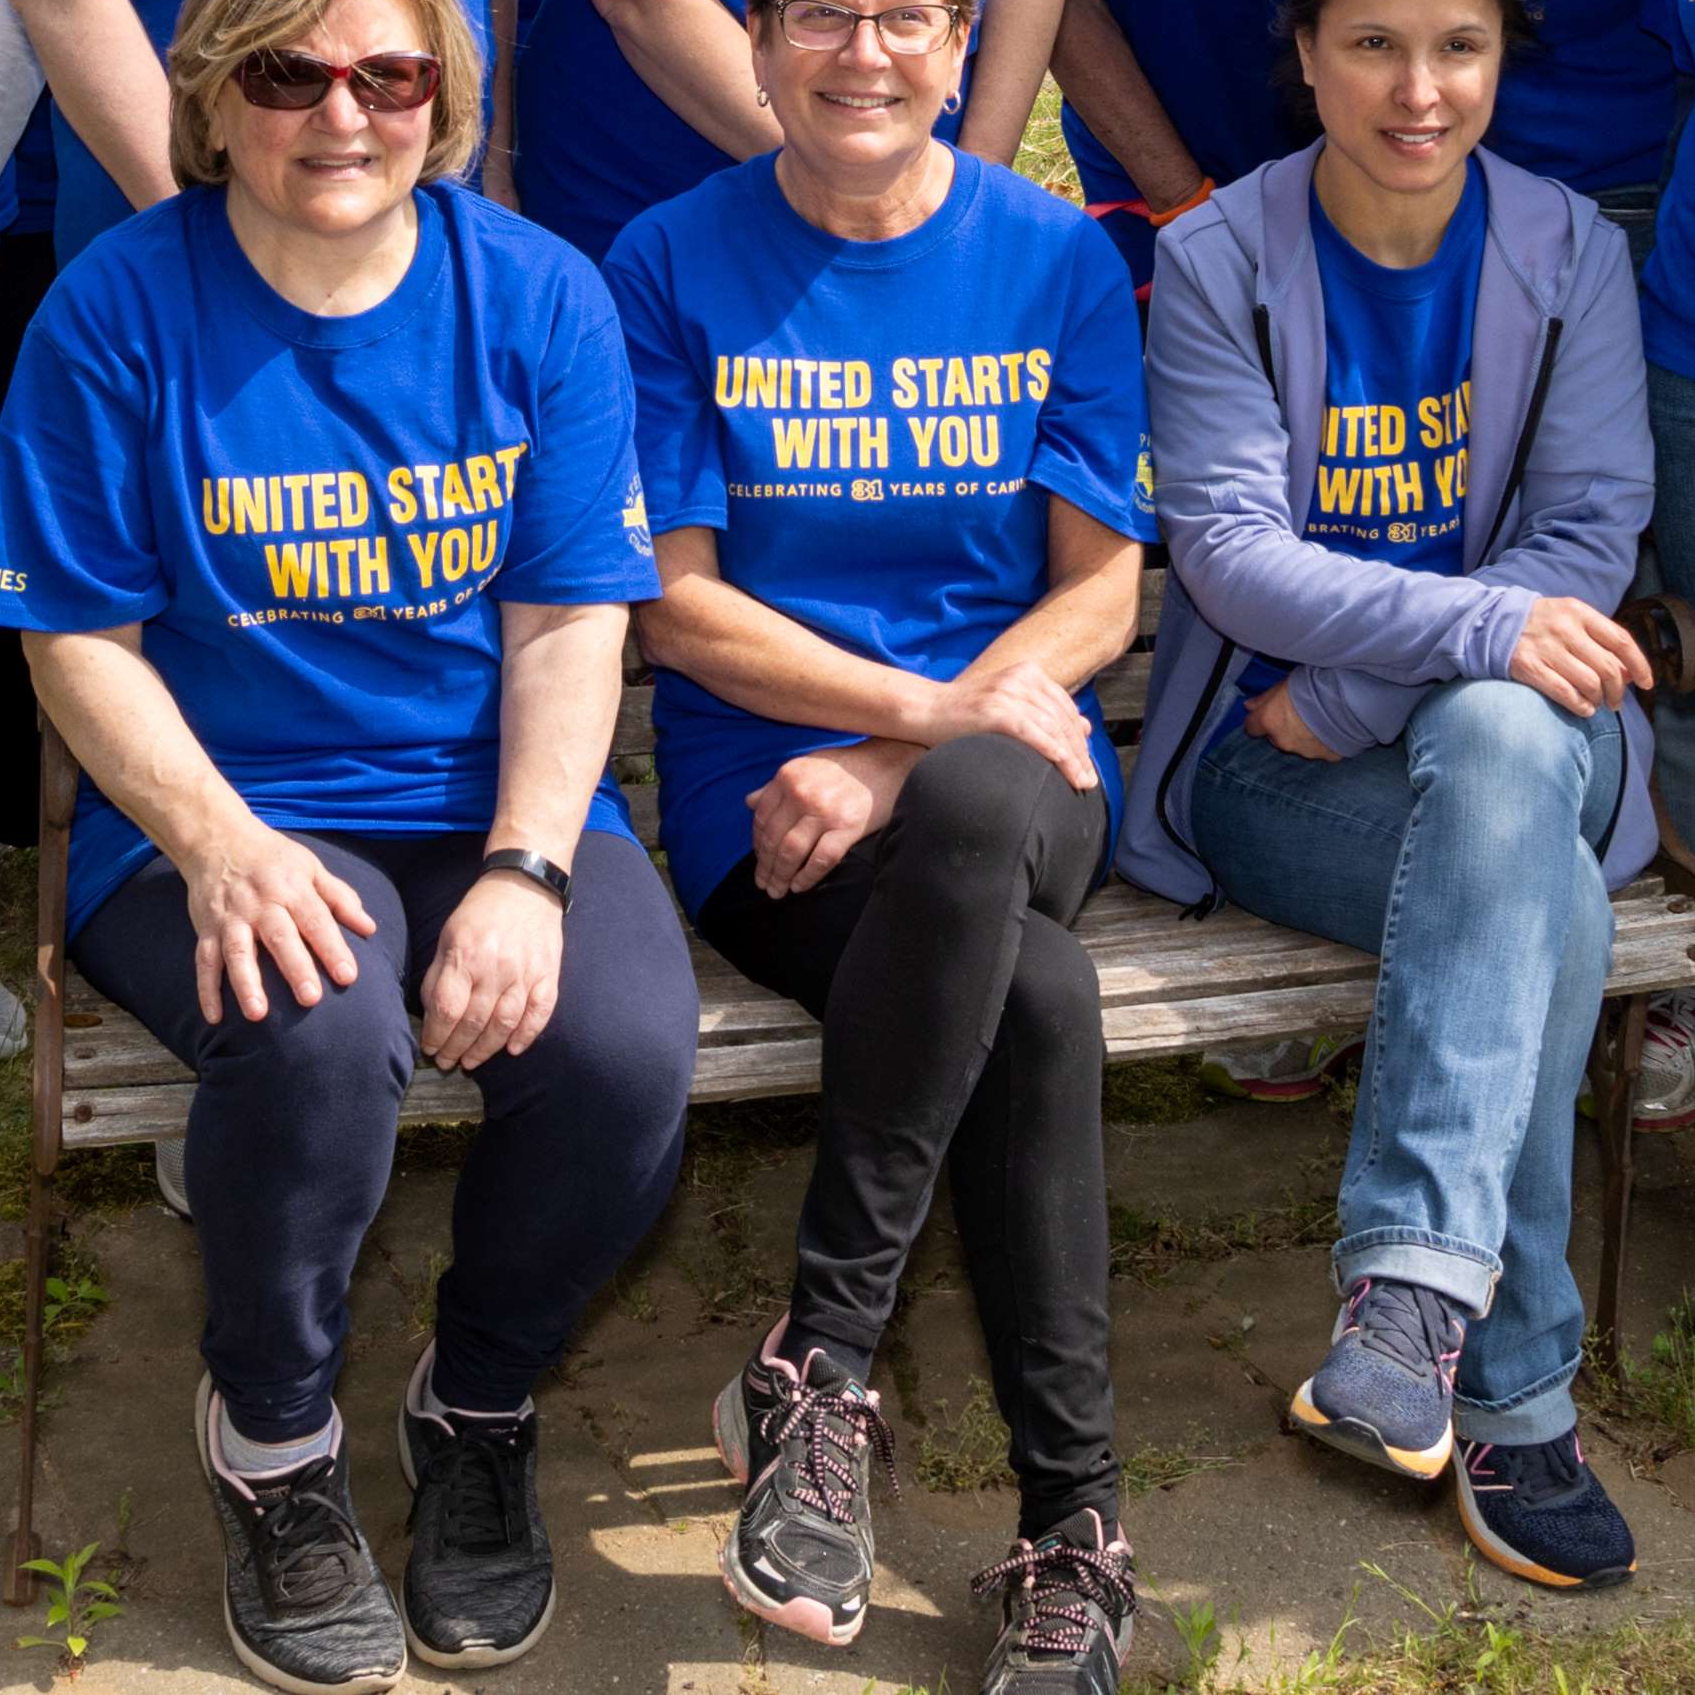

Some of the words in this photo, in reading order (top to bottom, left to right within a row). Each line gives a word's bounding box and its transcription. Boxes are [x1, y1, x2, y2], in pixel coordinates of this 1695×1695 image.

[715, 356, 872, 409] UNITED
[892, 348, 1051, 408] STARTS
[771, 417, 889, 469] WITH
[907, 414, 1000, 468] YOU
[1321, 404, 1406, 457] ITED
[202, 470, 369, 536] UNITED
[387, 441, 527, 525] START
[728, 482, 843, 498] CELEBRATING
[890, 481, 946, 497] YEARS
[955, 482, 979, 496] OF
[1318, 461, 1424, 517] WITH
[1434, 448, 1469, 507] YO
[1308, 522, 1379, 540] BRATING
[264, 535, 391, 599] WITH
[407, 519, 498, 590] YOU
[227, 609, 345, 628] CELEBRATING
[393, 599, 448, 620] YEARS
[454, 587, 474, 605] OF
